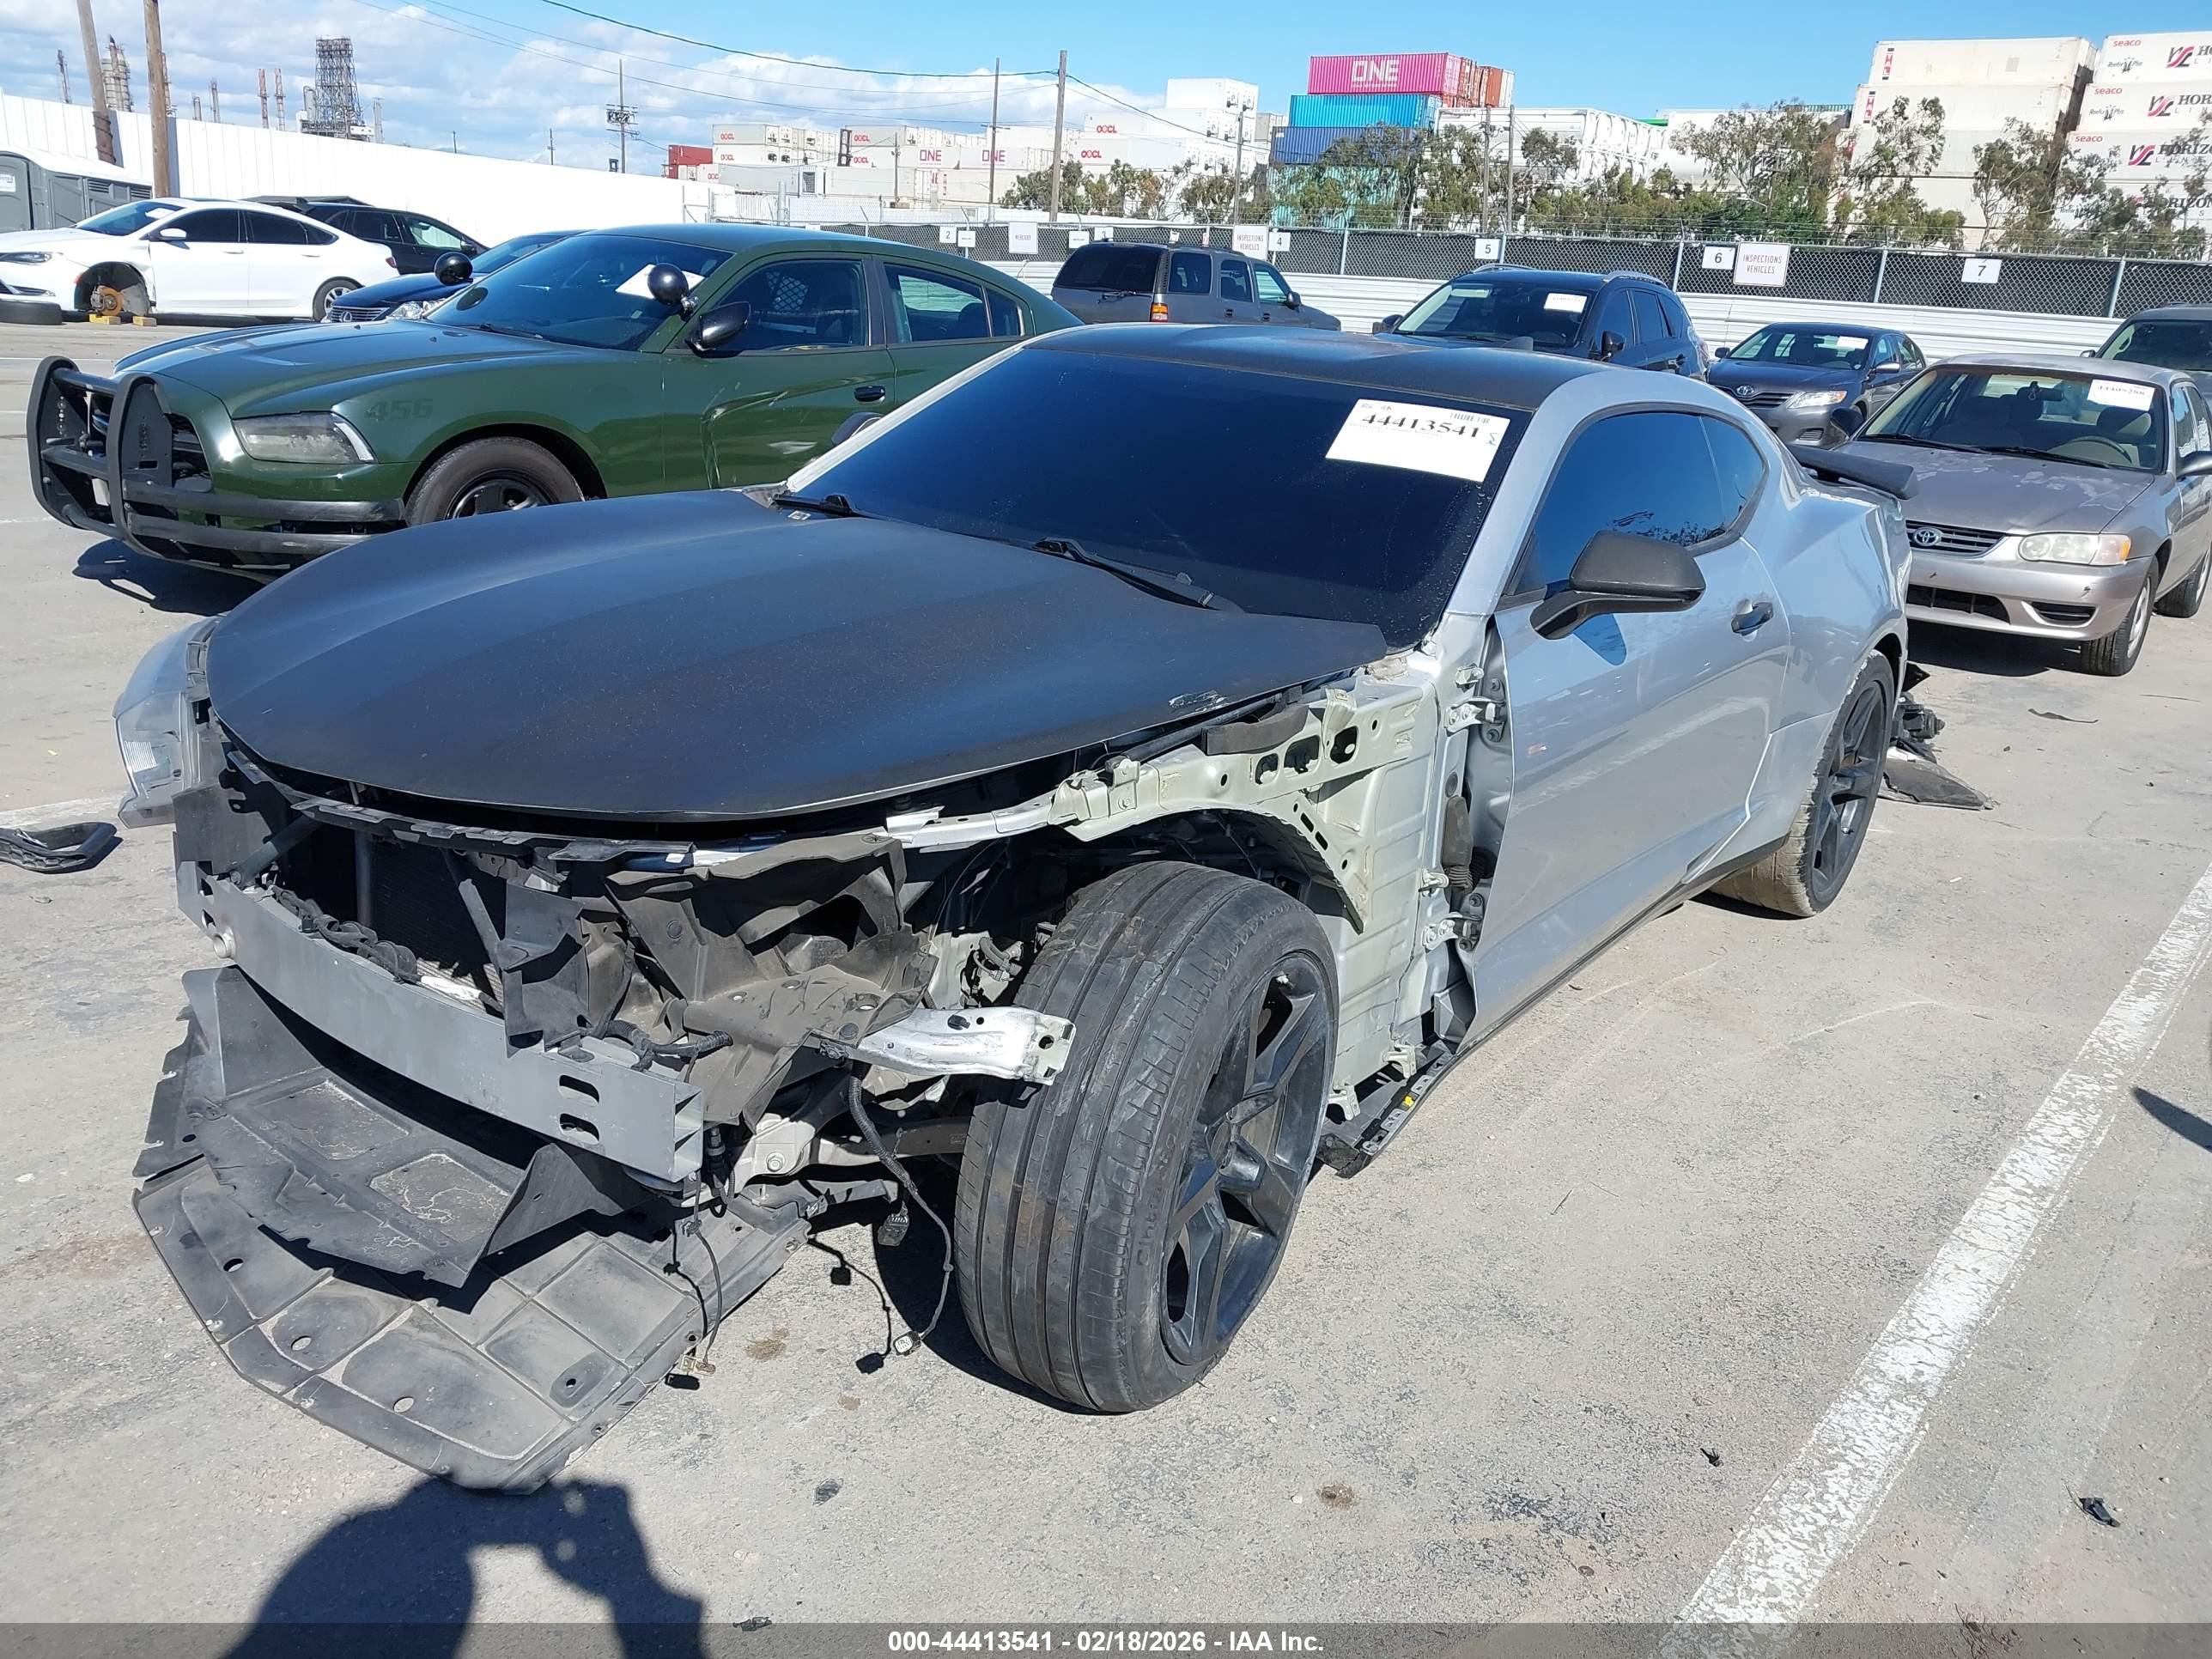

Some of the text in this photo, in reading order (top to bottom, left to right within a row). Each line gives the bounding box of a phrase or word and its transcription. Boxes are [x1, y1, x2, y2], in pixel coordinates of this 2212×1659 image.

[1352, 59, 1400, 82] ONE
[1096, 125, 1118, 133] OOCL
[919, 149, 943, 162] ONE
[1080, 149, 1103, 159] OOCL
[945, 230, 951, 240] 2
[1237, 234, 1265, 243] INSPECTIONS
[1239, 243, 1261, 252] VEHICLES
[1276, 237, 1283, 247] 4
[1485, 244, 1492, 255] 5
[1714, 252, 1723, 264] 6
[1742, 253, 1784, 264] INSPECTIONS
[1746, 264, 1776, 275] VEHICLES
[1978, 264, 1988, 276] 7
[364, 398, 434, 421] 456
[1361, 413, 1480, 438] 44413541
